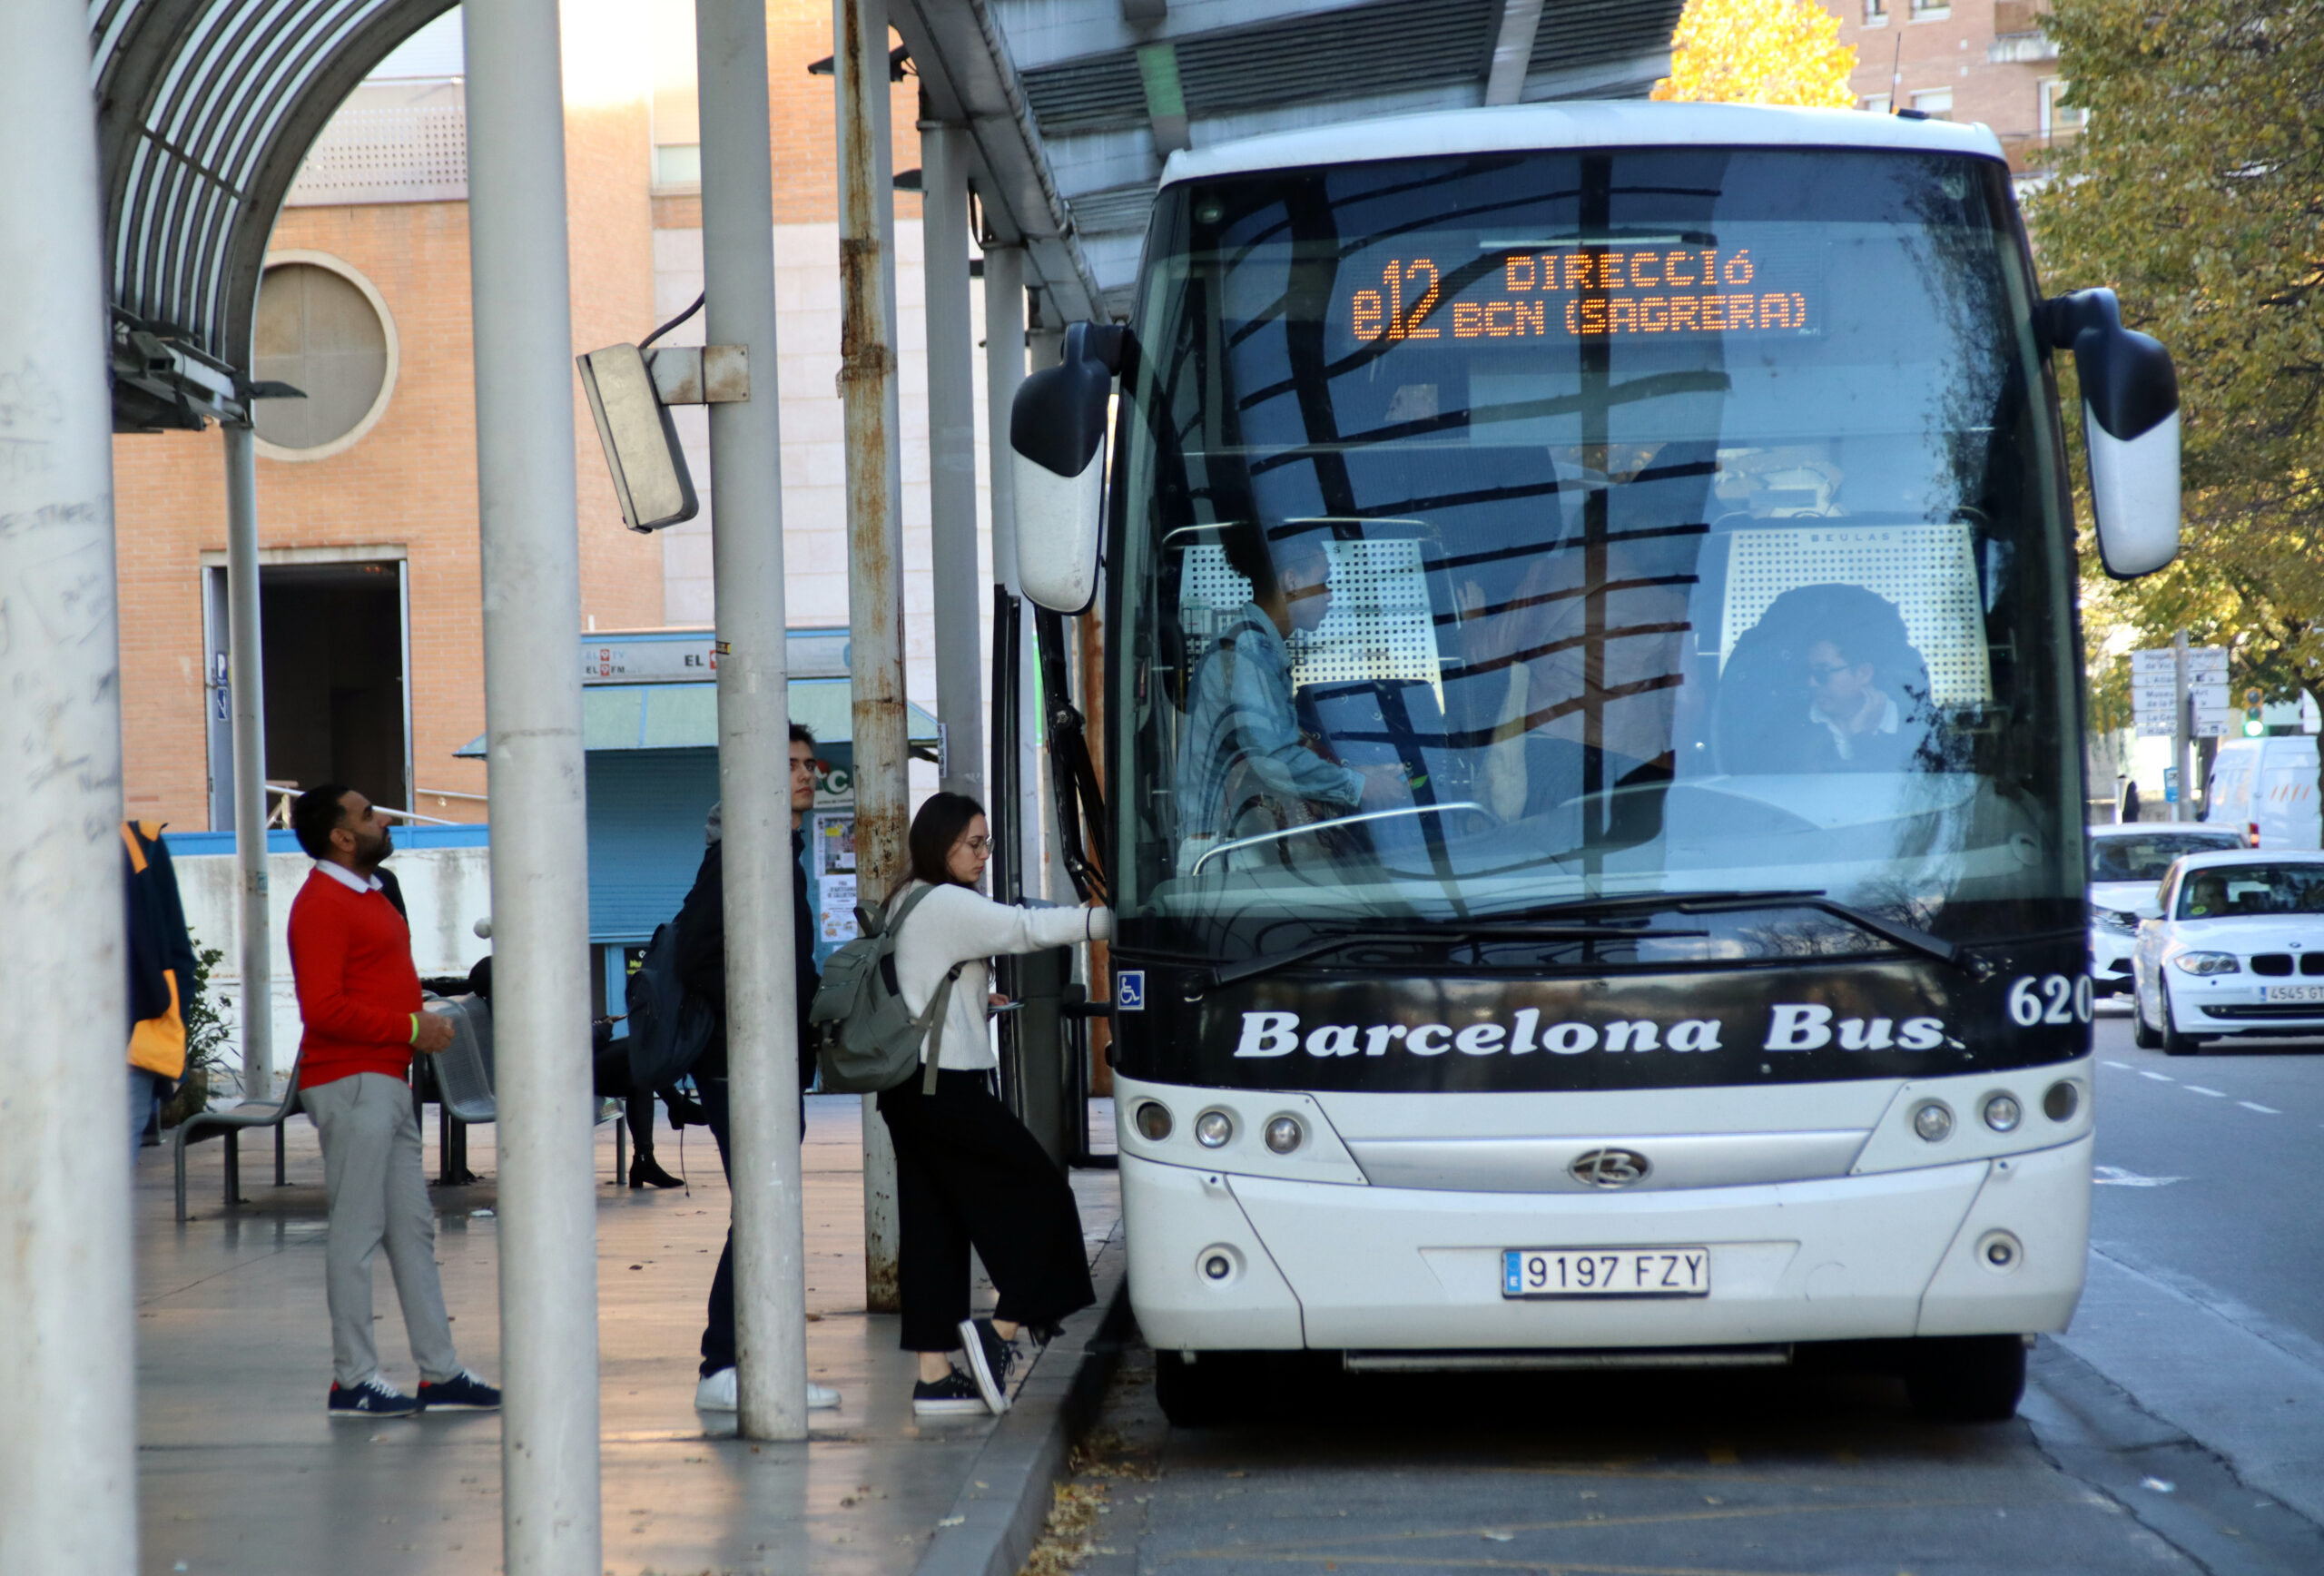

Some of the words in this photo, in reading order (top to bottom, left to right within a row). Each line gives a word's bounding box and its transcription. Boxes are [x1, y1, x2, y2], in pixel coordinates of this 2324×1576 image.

[1352, 259, 1440, 340] e12
[1453, 300, 1545, 338] BCN
[1565, 291, 1806, 335] (SAGRERA)
[1810, 532, 1890, 543] BEULAS
[586, 665, 598, 675] EL
[611, 665, 625, 674] FM
[684, 654, 704, 667] EL
[1233, 1007, 1723, 1059] Barcelona
[1764, 1003, 1945, 1051] Bus
[1528, 1256, 1620, 1288] 9197
[1636, 1255, 1703, 1287] FZY
